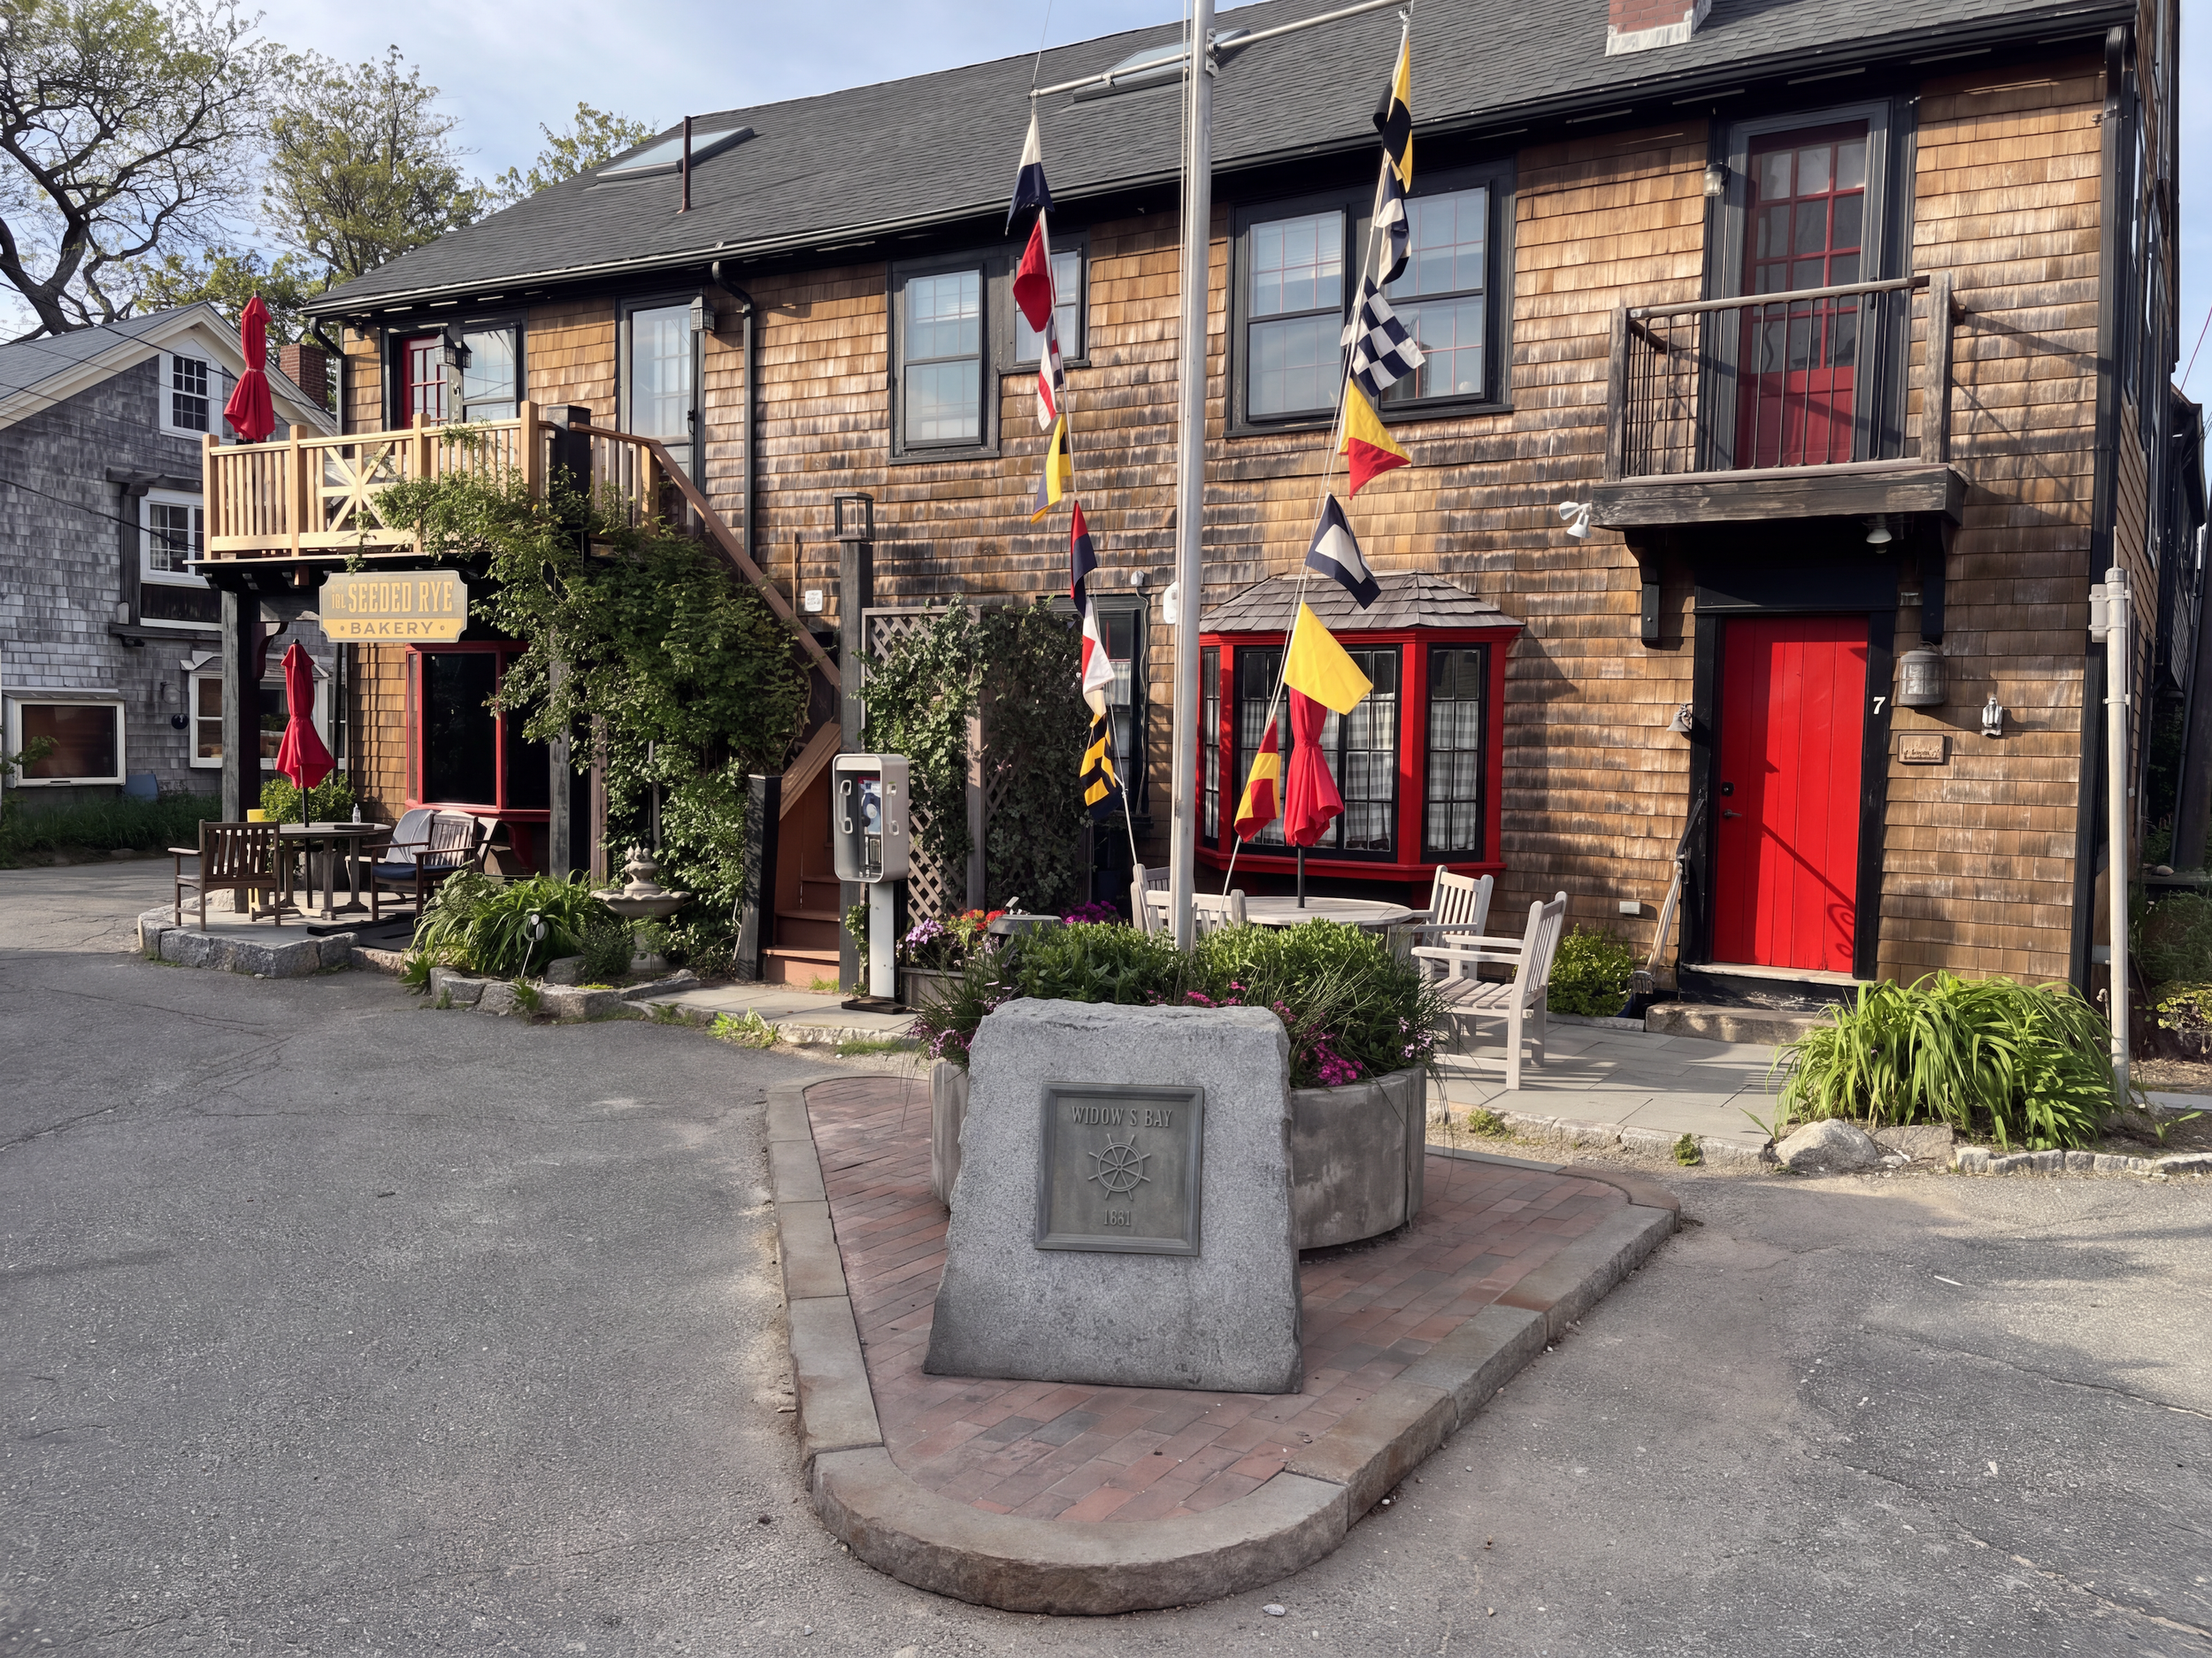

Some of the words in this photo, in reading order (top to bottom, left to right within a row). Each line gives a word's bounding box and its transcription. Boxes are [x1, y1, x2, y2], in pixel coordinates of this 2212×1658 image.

[348, 582, 412, 613] SEEDED
[418, 580, 454, 612] RYE
[350, 621, 434, 634] BAKERY
[1873, 696, 1886, 715] 7
[1144, 1109, 1173, 1128] BAY
